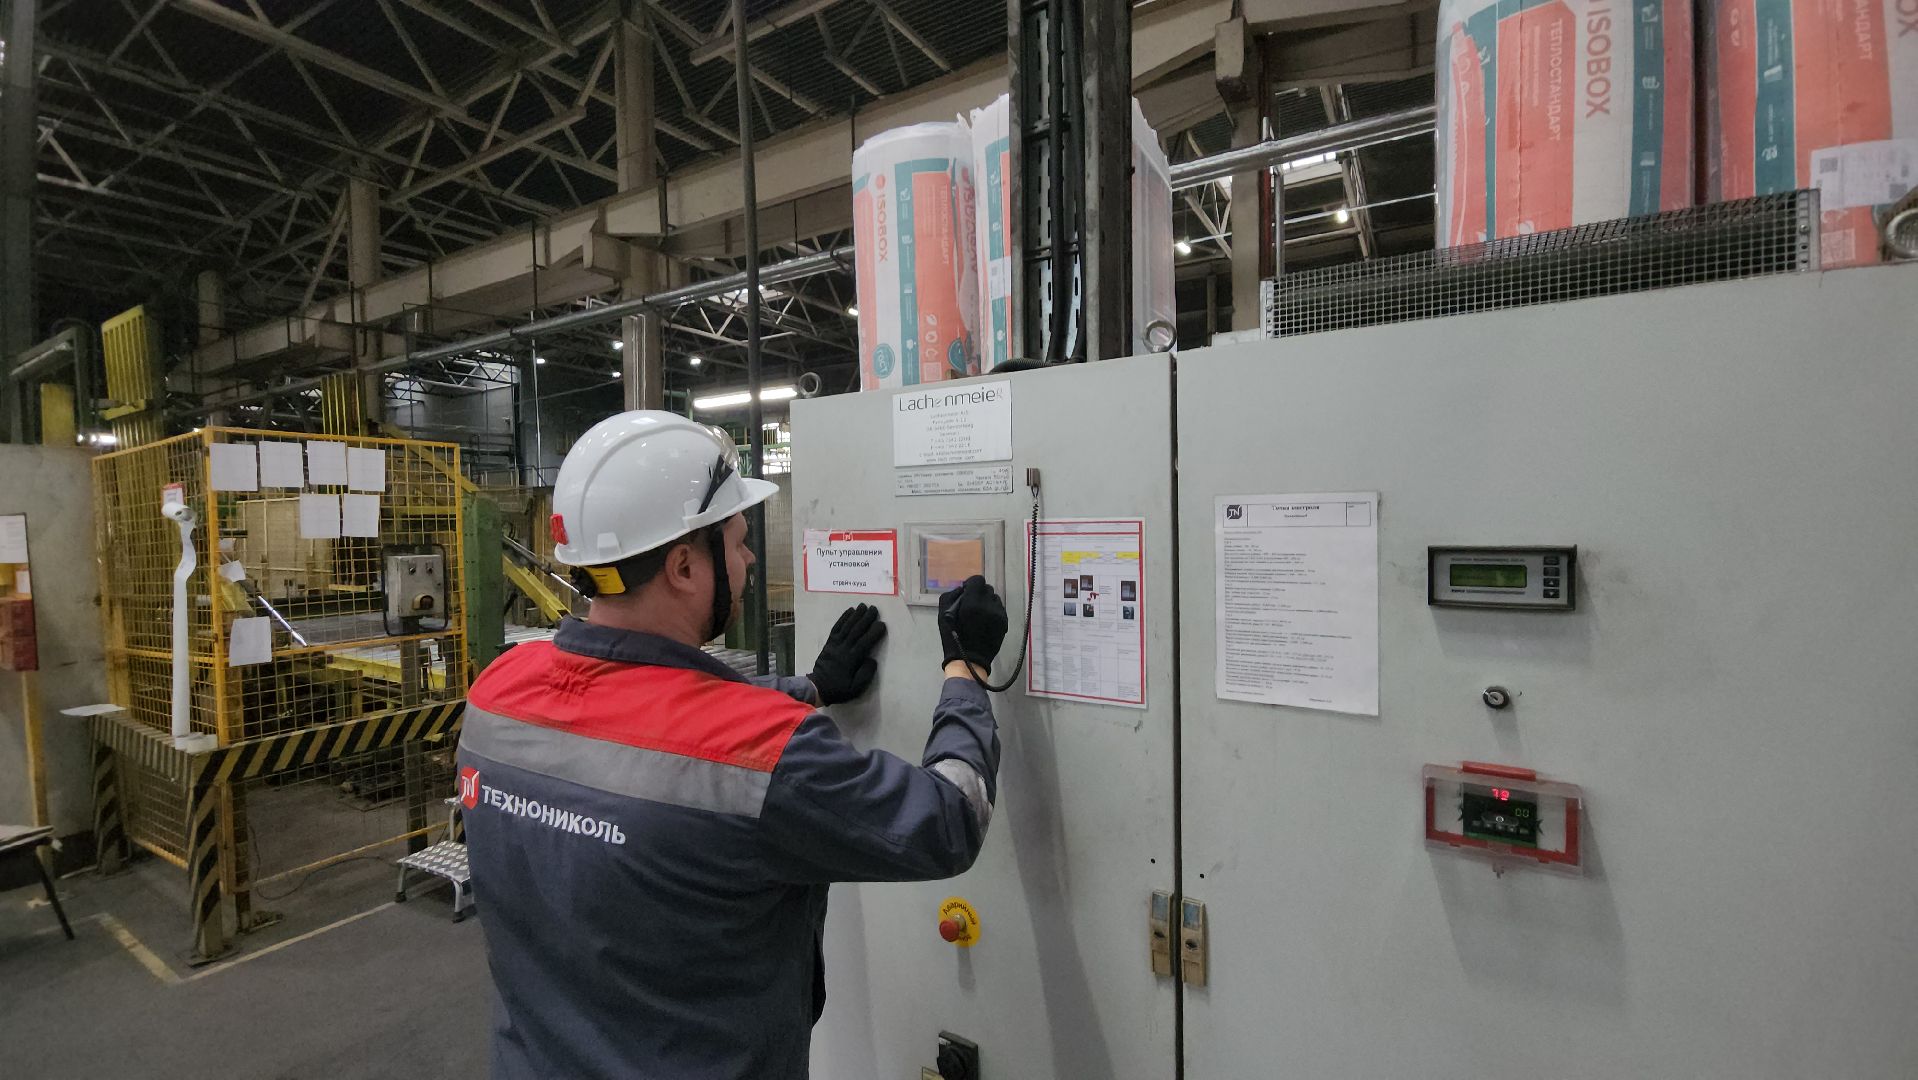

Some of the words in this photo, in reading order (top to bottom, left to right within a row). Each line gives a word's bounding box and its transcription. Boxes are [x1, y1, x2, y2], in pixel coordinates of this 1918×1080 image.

[1547, 18, 1563, 140] ТЕПЛОСТАНДАРТ
[1585, 8, 1611, 119] ISOBOX
[877, 194, 888, 263] ISOBOX
[816, 547, 838, 557] Пульт
[839, 549, 883, 558] управления
[481, 784, 626, 845] ТЕХНОНИКОЛЬ
